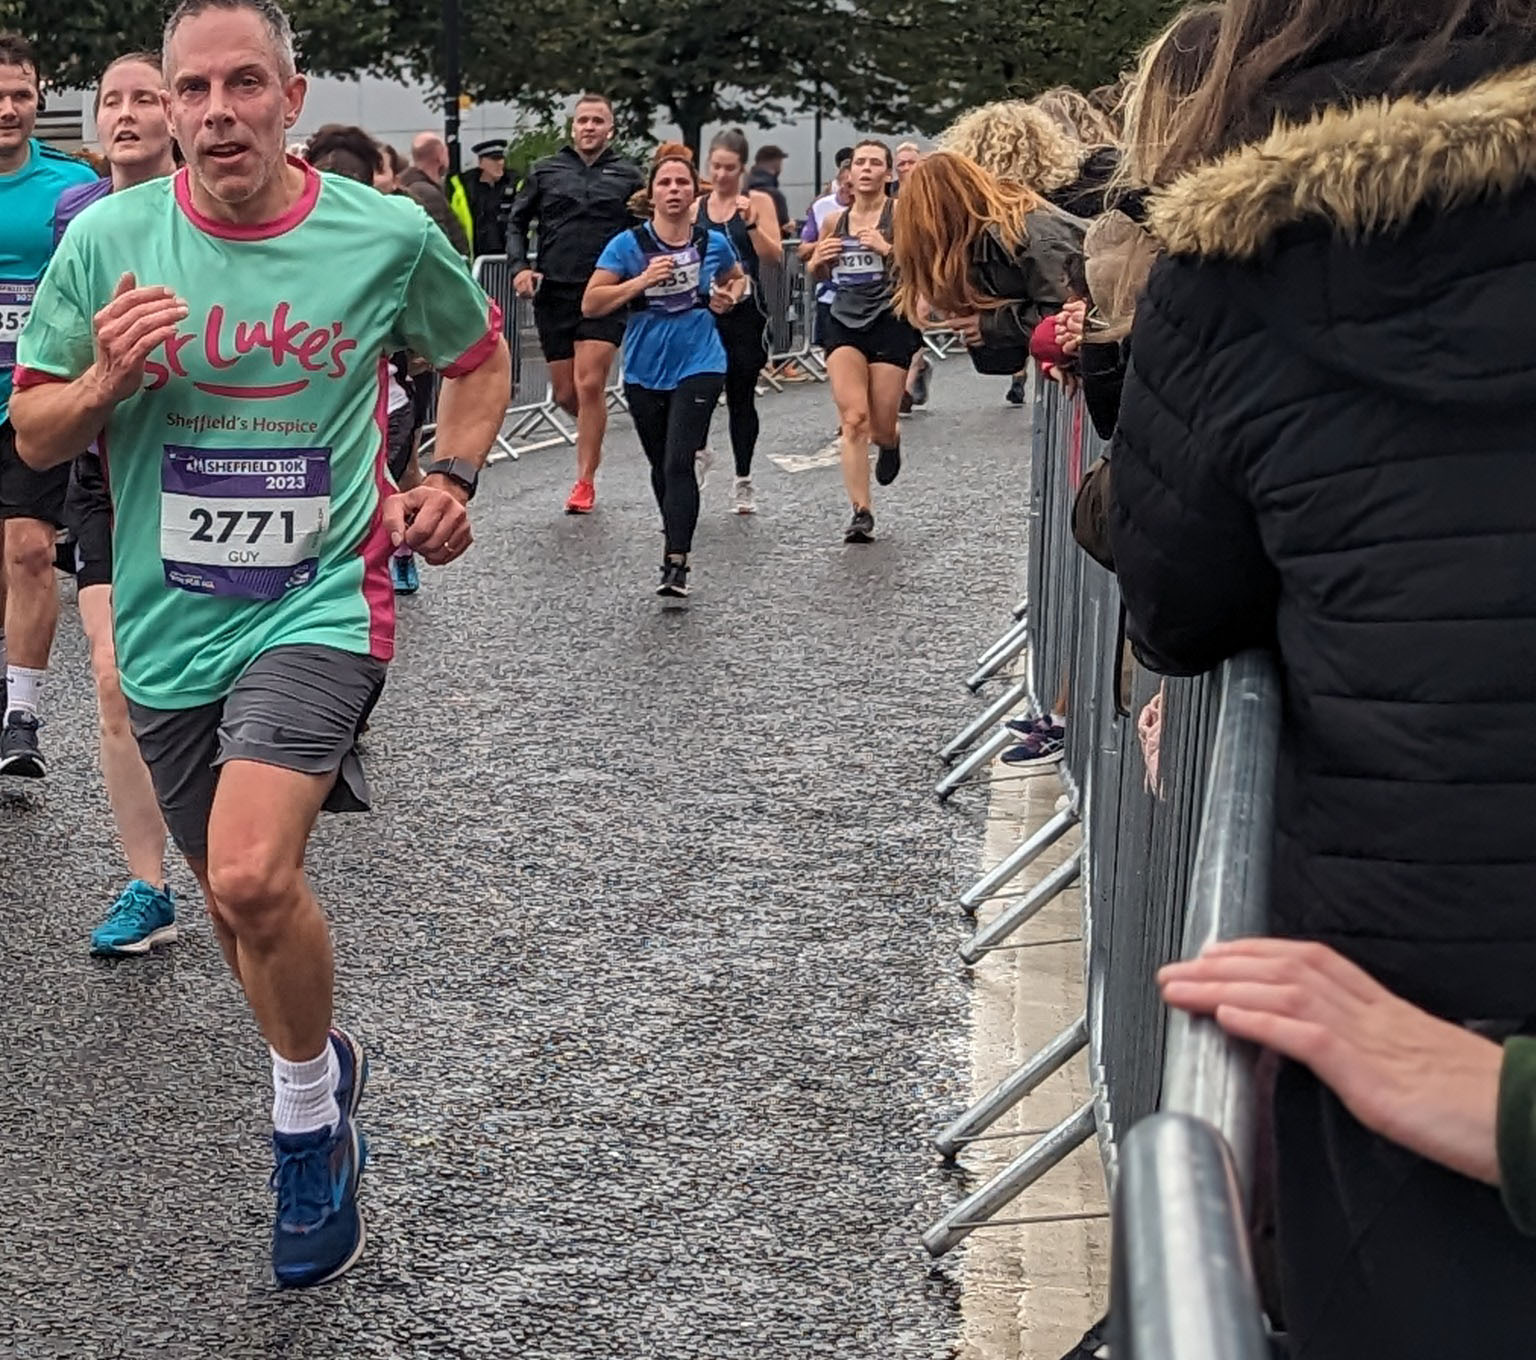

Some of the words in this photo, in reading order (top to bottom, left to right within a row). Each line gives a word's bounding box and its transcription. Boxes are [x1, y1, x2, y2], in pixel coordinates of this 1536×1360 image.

[842, 254, 873, 267] 1210
[205, 302, 357, 379] Luke's
[166, 412, 248, 433] Sheffield's
[253, 416, 318, 436] Hospice
[207, 460, 277, 473] SHEFFIELD
[280, 460, 305, 473] 10K
[265, 476, 306, 489] 2023
[189, 508, 295, 544] 2771
[228, 551, 260, 563] GUY
